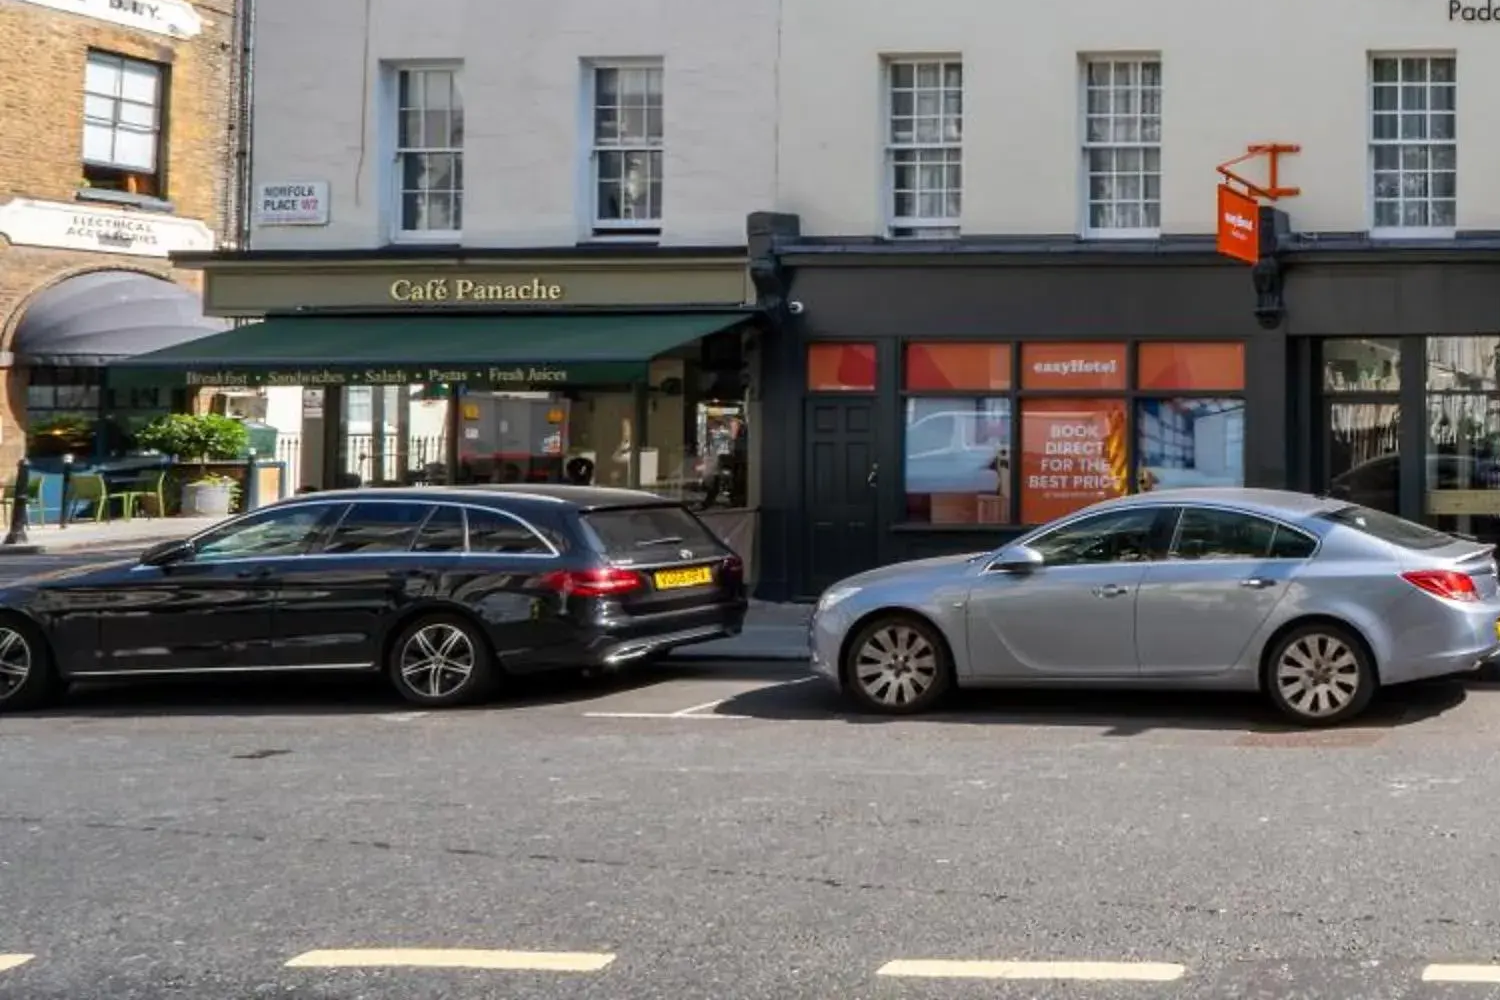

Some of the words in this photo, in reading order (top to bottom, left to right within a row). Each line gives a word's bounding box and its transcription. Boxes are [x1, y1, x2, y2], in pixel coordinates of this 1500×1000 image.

[264, 185, 315, 197] NORFOLK
[263, 199, 298, 211] PLACE
[301, 199, 318, 210] W2
[390, 278, 447, 301] Café
[456, 277, 561, 300] Panache
[1033, 359, 1117, 376] easyHotel
[186, 370, 248, 385] Breakfast
[267, 368, 346, 385] Sandwiches
[364, 368, 407, 383] Salads
[488, 367, 524, 382] Fresh
[528, 366, 567, 382] Juices
[1050, 423, 1099, 438] BOOK
[1045, 441, 1105, 455] DIRECT
[1041, 458, 1073, 472] FOR
[1079, 458, 1112, 473] THE
[1029, 475, 1068, 489] BEST
[1073, 475, 1121, 490] PRICE
